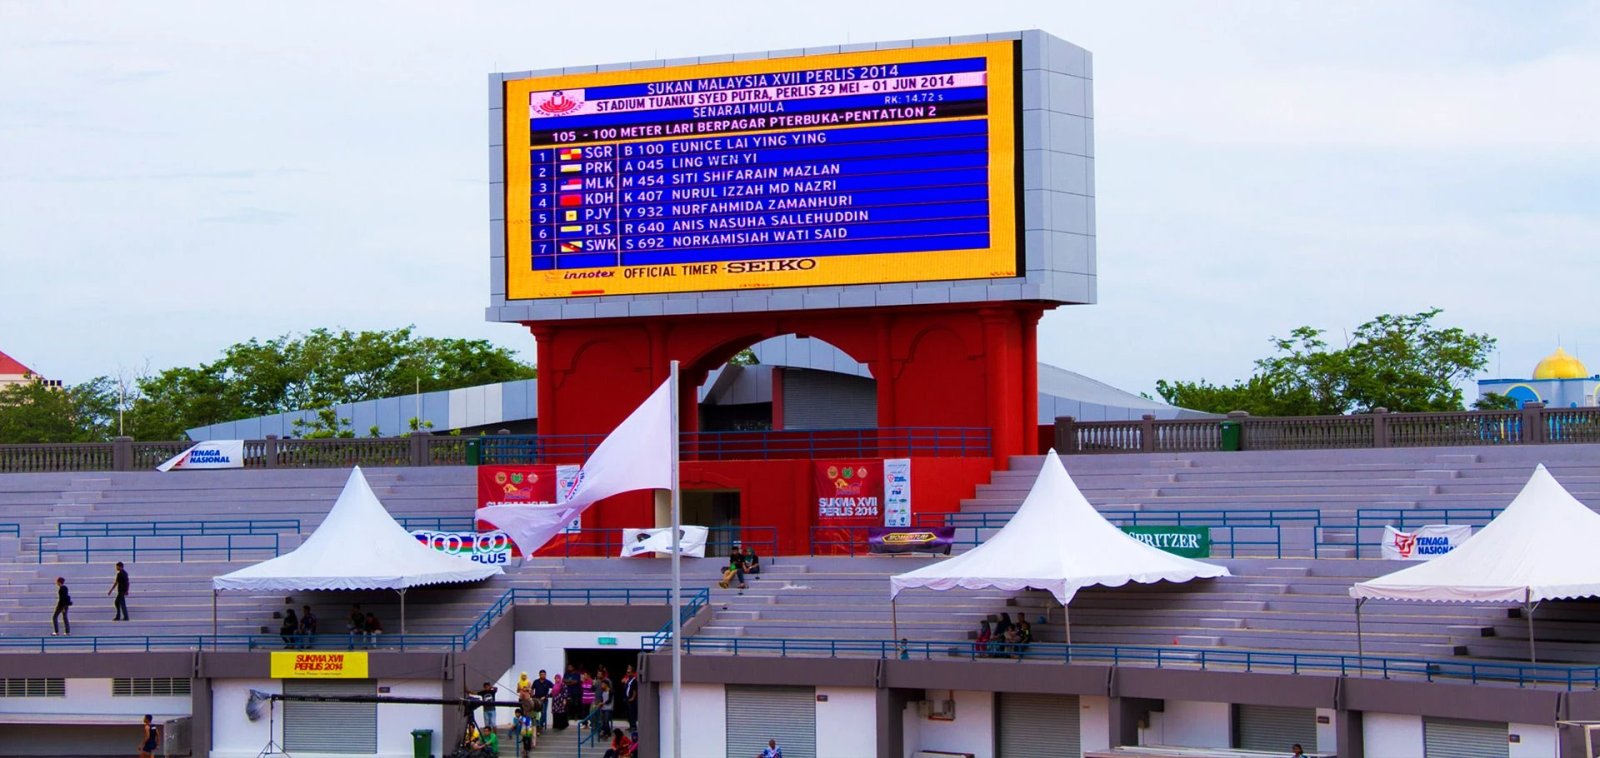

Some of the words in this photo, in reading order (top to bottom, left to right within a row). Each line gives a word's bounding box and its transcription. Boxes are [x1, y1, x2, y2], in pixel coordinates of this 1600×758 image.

[647, 79, 694, 95] SUKAN
[698, 74, 768, 92] MALAYSIA
[773, 72, 801, 85] XVII
[806, 68, 855, 83] PERLIS
[860, 65, 899, 79] 2014
[596, 97, 646, 112] STADIUM
[648, 94, 694, 108] TUANKU
[698, 91, 728, 105] SYED
[731, 88, 772, 103] PUTRA,
[776, 85, 816, 99] PERLIS
[819, 83, 836, 96] 29
[839, 81, 860, 94] MEI
[872, 79, 889, 91] 01
[892, 77, 917, 90] JUN
[920, 75, 955, 88] 2014
[884, 95, 902, 105] RK:
[905, 92, 934, 103] 14.72
[693, 103, 746, 118] SENARAI
[749, 101, 785, 115] MULA
[552, 131, 576, 142] 105
[593, 128, 617, 139] 100
[620, 125, 662, 138] METER
[665, 123, 694, 135] LARI
[697, 118, 766, 132] BERPAGAR
[769, 106, 924, 127] PTERBUKA-PENTATLON
[928, 106, 937, 117] 2
[540, 152, 546, 162] 1
[585, 146, 613, 159] SGR
[624, 147, 633, 156] B
[638, 144, 664, 155] 100
[671, 139, 722, 153] EUNICE
[727, 138, 748, 149] LAI
[753, 135, 787, 147] YING
[792, 132, 827, 145] YING
[539, 168, 546, 177] 2
[585, 161, 613, 173] PRK
[625, 162, 633, 172] A
[637, 159, 664, 170] 045
[672, 157, 703, 169] LING
[708, 154, 739, 166] WEN
[743, 153, 757, 164] YI
[539, 183, 547, 193] 3
[585, 177, 615, 189] MLK
[622, 177, 633, 187] M
[638, 174, 664, 185] 454
[672, 173, 698, 185] SITI
[703, 167, 778, 182] SHIFARAIN
[783, 163, 840, 177] MAZLAN
[539, 199, 547, 208] 4
[585, 192, 614, 205] KDH
[624, 193, 633, 202] K
[637, 190, 663, 201] 407
[672, 187, 718, 200] NURUL
[723, 184, 763, 197] IZZAH
[769, 182, 790, 194] MD
[794, 180, 837, 193] NAZRI
[539, 213, 547, 223] 5
[586, 208, 612, 220] PJY
[624, 209, 632, 218] Y
[638, 206, 664, 217] 932
[672, 201, 764, 216] NURFAHMIDA
[768, 195, 852, 210] ZAMANHURI
[539, 229, 547, 238] 6
[586, 223, 611, 235] PLS
[625, 224, 633, 233] R
[638, 222, 665, 232] 640
[673, 219, 705, 231] ANIS
[709, 216, 766, 230] NASUHA
[771, 210, 869, 226] SALLEHUDDIN
[539, 244, 547, 254] 7
[586, 239, 617, 251] SWK
[626, 239, 634, 249] S
[638, 238, 665, 249] 692
[673, 232, 769, 247] NORKAMISIAH
[773, 230, 809, 242] WATI
[814, 227, 848, 240] SAID
[564, 270, 616, 280] innotex
[624, 265, 677, 279] OFFICIAL
[682, 263, 718, 276] TIMER
[190, 456, 231, 464] NASIONAL
[819, 497, 856, 507] SUKMA
[857, 496, 878, 506] XVII
[819, 506, 854, 517] PERLIS
[855, 506, 879, 516] 2014
[469, 531, 508, 554] 100
[1416, 537, 1449, 545] TENAGA
[1418, 545, 1456, 555] NASION
[294, 662, 323, 671] PERLIS
[324, 662, 343, 671] 2014
[296, 654, 327, 663] SUKMA
[328, 654, 344, 662] XVII
